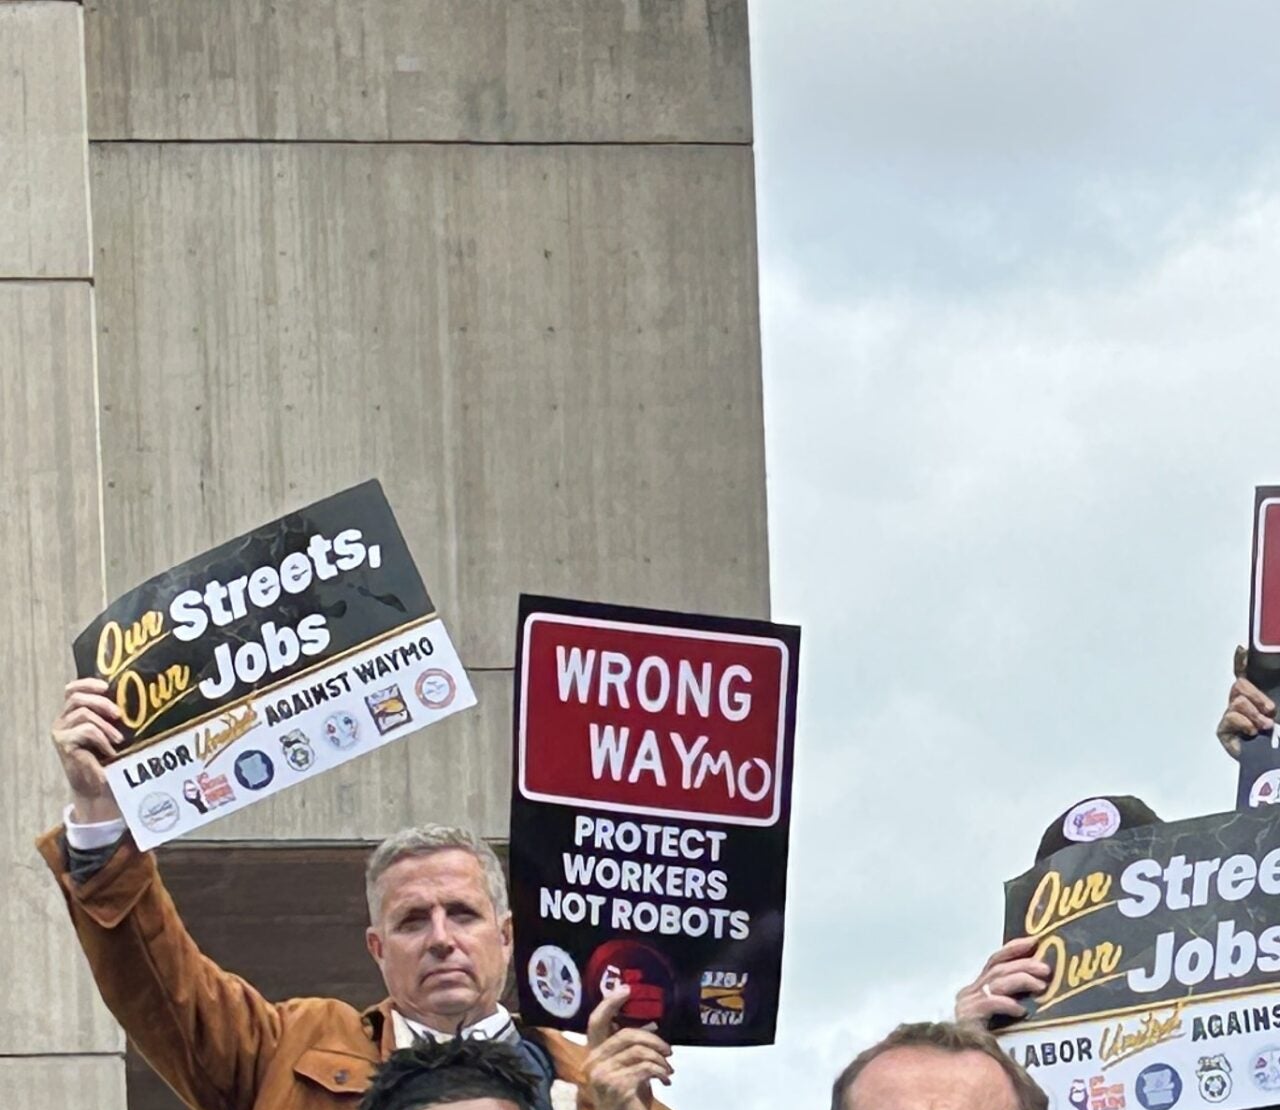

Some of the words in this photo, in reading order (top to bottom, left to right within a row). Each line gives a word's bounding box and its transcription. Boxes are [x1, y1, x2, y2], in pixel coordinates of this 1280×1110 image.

[96, 610, 167, 680] Our
[169, 528, 382, 642] Streets,
[116, 663, 194, 733] Our
[199, 613, 330, 700] Jobs
[556, 645, 752, 723] WRONG
[123, 744, 194, 789] LABOR
[265, 671, 353, 728] AGAINST
[355, 636, 434, 684] WAYMO
[589, 722, 771, 801] WAYMO
[562, 852, 728, 901] WORKERS
[574, 815, 727, 862] PROTECT
[539, 887, 606, 927] NOT
[611, 904, 750, 941] ROBOTS
[1025, 870, 1113, 936] Our
